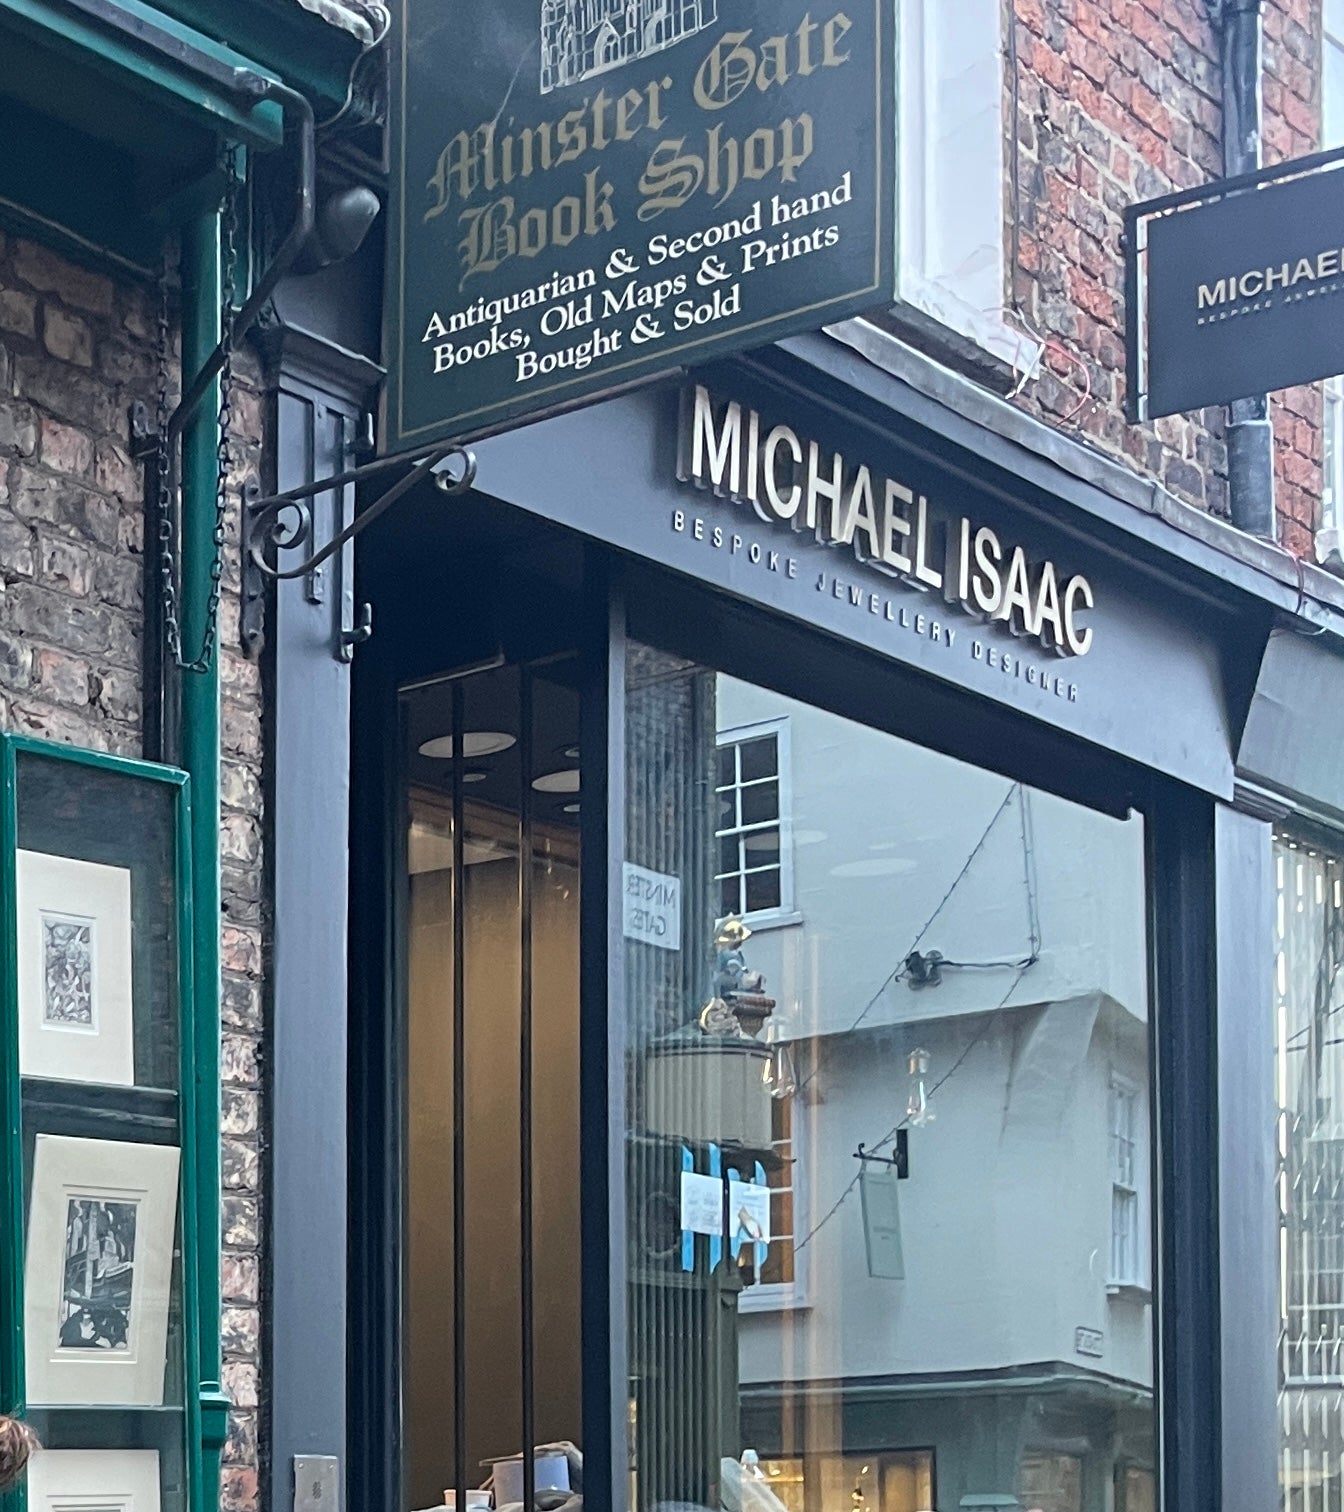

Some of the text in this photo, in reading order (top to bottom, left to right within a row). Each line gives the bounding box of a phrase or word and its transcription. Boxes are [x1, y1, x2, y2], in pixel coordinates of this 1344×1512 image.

[423, 12, 853, 225] Minster Gate
[458, 111, 814, 293] Book Shop
[421, 172, 853, 343] Antiquarian & Second hand
[433, 225, 839, 374] Books, Old Maps & Prints
[515, 284, 741, 382] Bought & Sold
[1198, 248, 1344, 309] MICHAE
[673, 510, 1079, 702] BESPOKE JEWELLERY DESIGNER
[692, 384, 1093, 657] MICHAEL ISAAC
